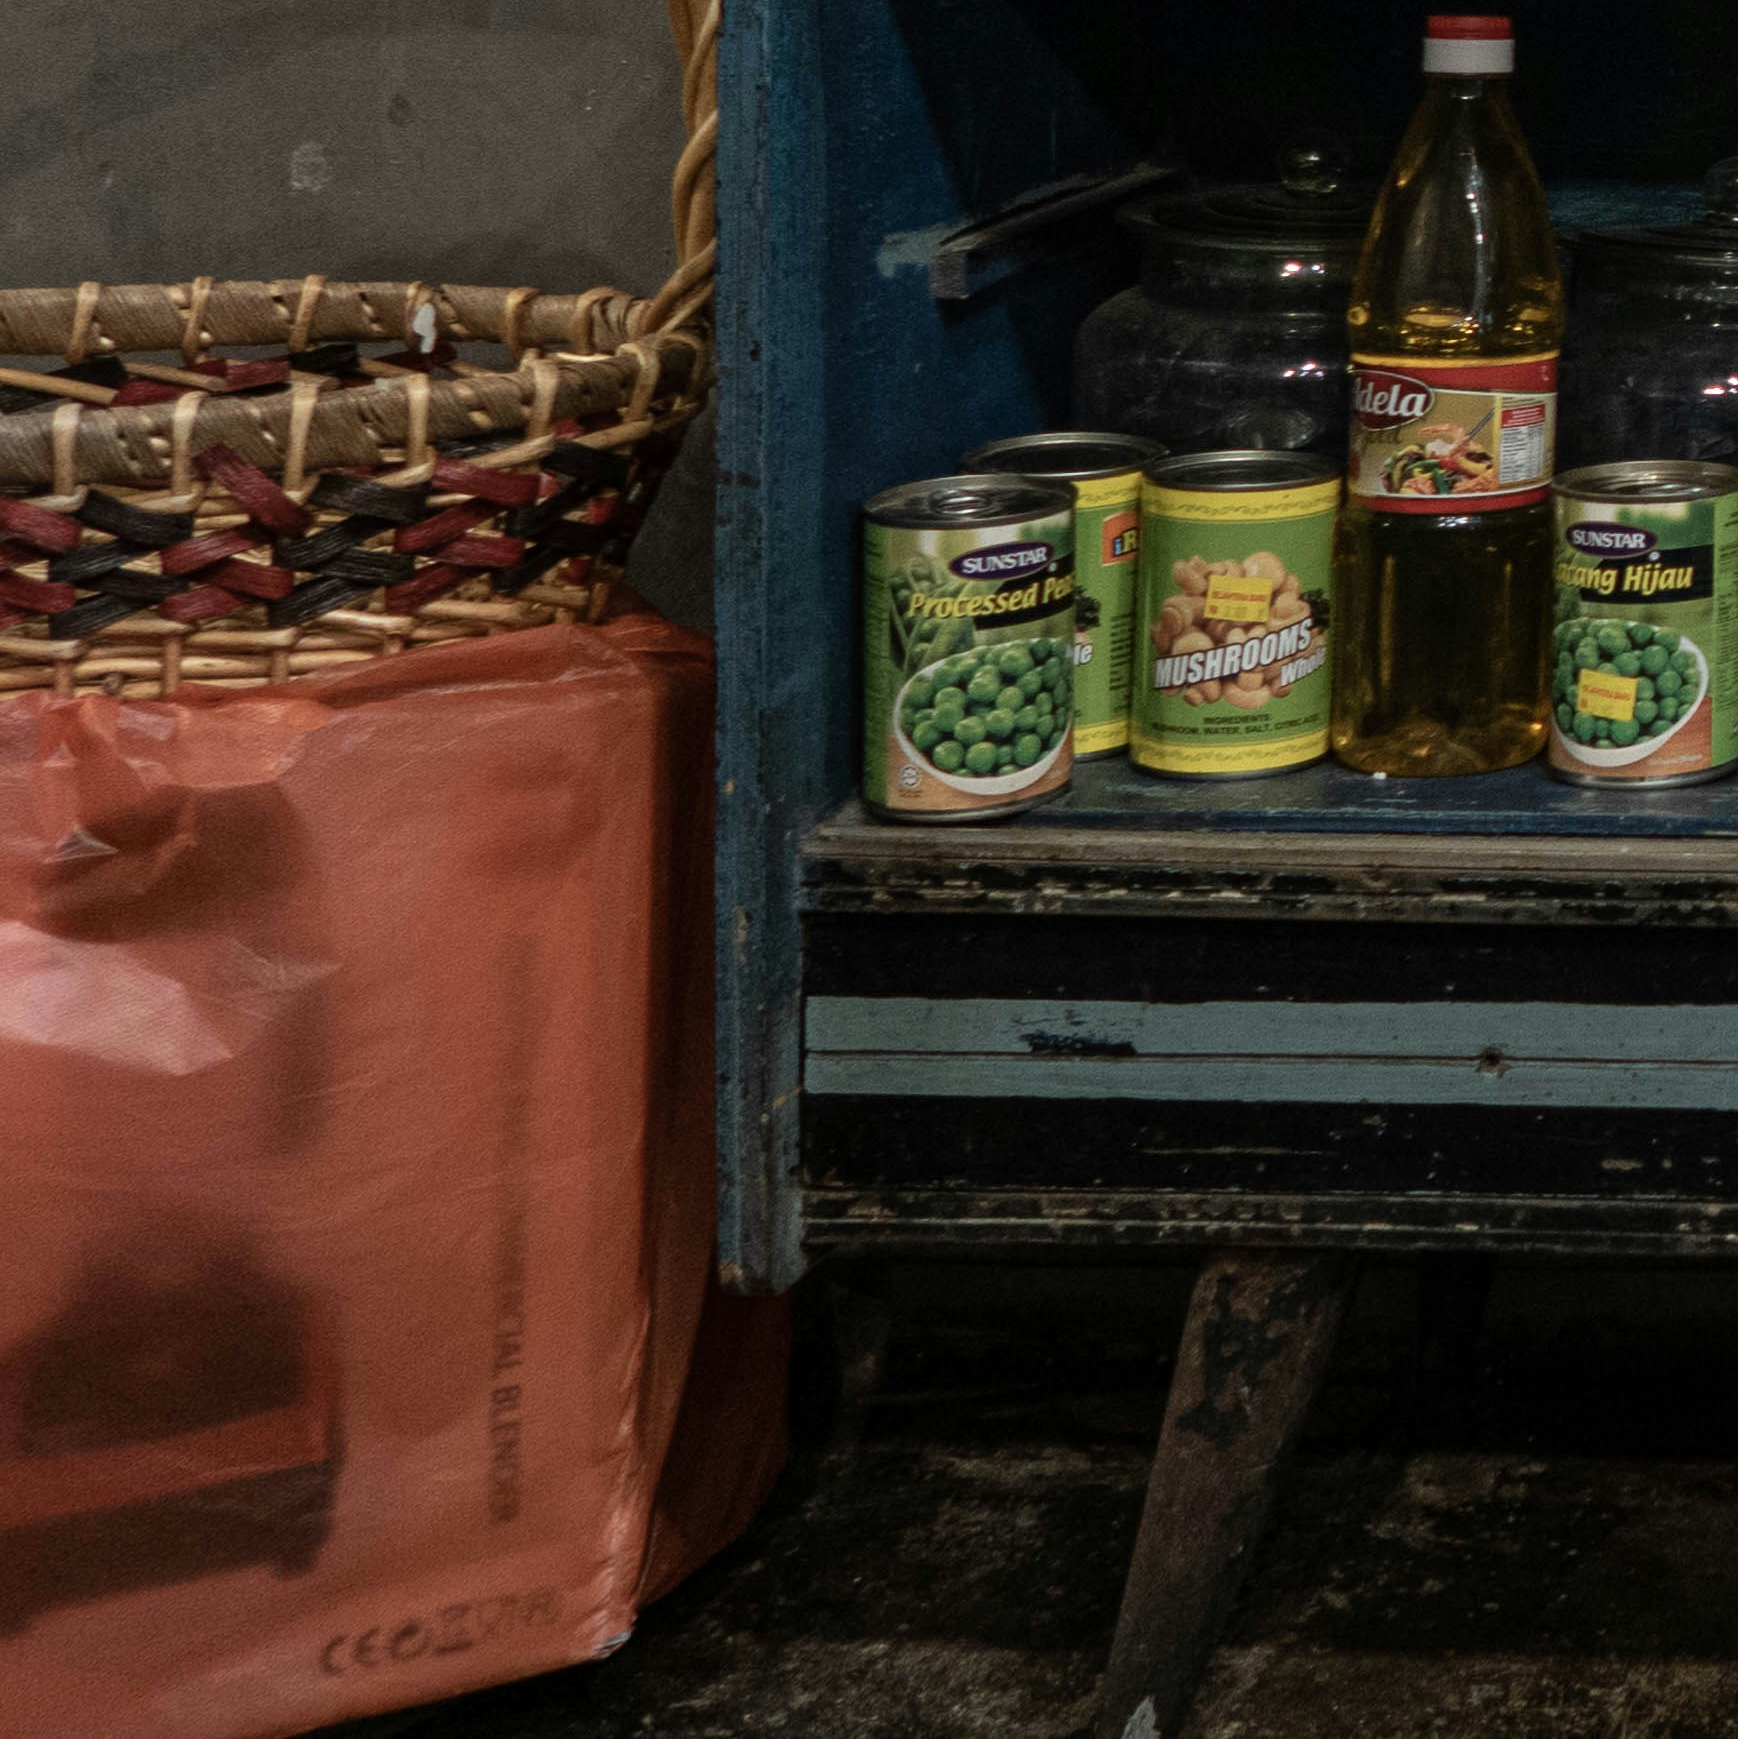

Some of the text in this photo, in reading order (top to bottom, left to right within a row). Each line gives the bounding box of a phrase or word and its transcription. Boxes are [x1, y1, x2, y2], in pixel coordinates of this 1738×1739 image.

[1571, 529, 1646, 549] SUNSTAR
[961, 546, 1049, 574] SUNSTAR
[1622, 563, 1694, 596] Hijau
[906, 573, 1076, 620] Processed Pea
[1155, 618, 1314, 688] MUSHROOMS
